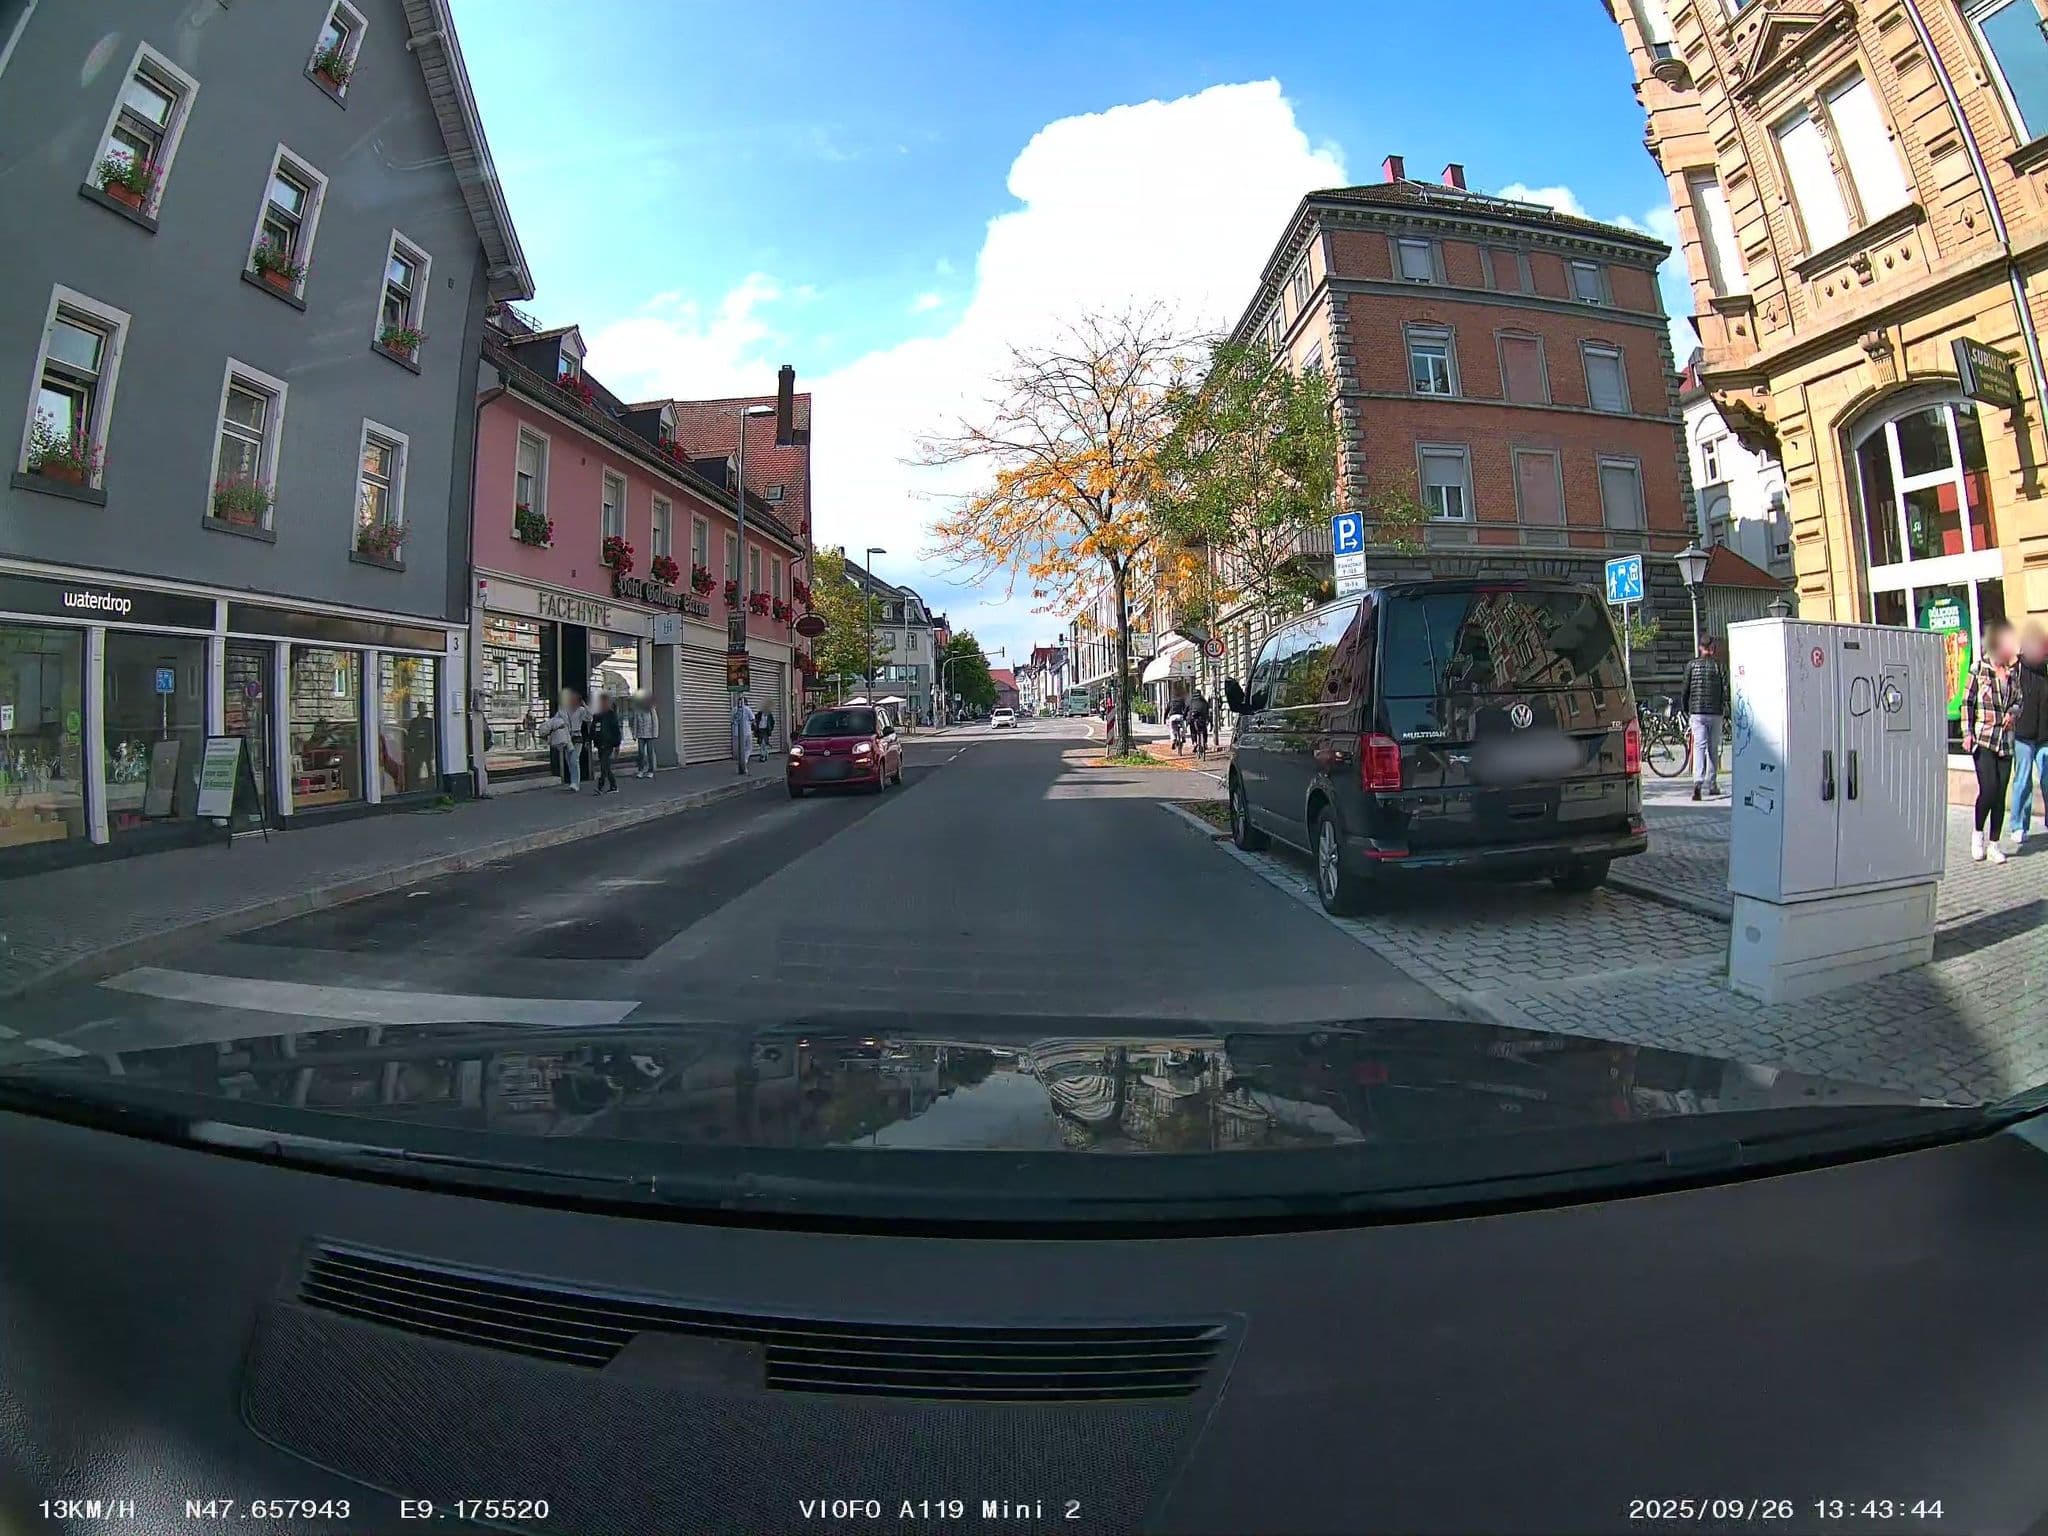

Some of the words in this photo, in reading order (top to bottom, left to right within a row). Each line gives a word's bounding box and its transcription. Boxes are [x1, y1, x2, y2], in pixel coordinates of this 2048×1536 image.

[1971, 348, 2007, 373] SUBWAY
[1339, 519, 1356, 550] P
[64, 591, 132, 615] waterdrop
[538, 592, 612, 627] FACEHYPE
[453, 637, 459, 650] 3
[1402, 730, 1446, 739] MULTIVAN
